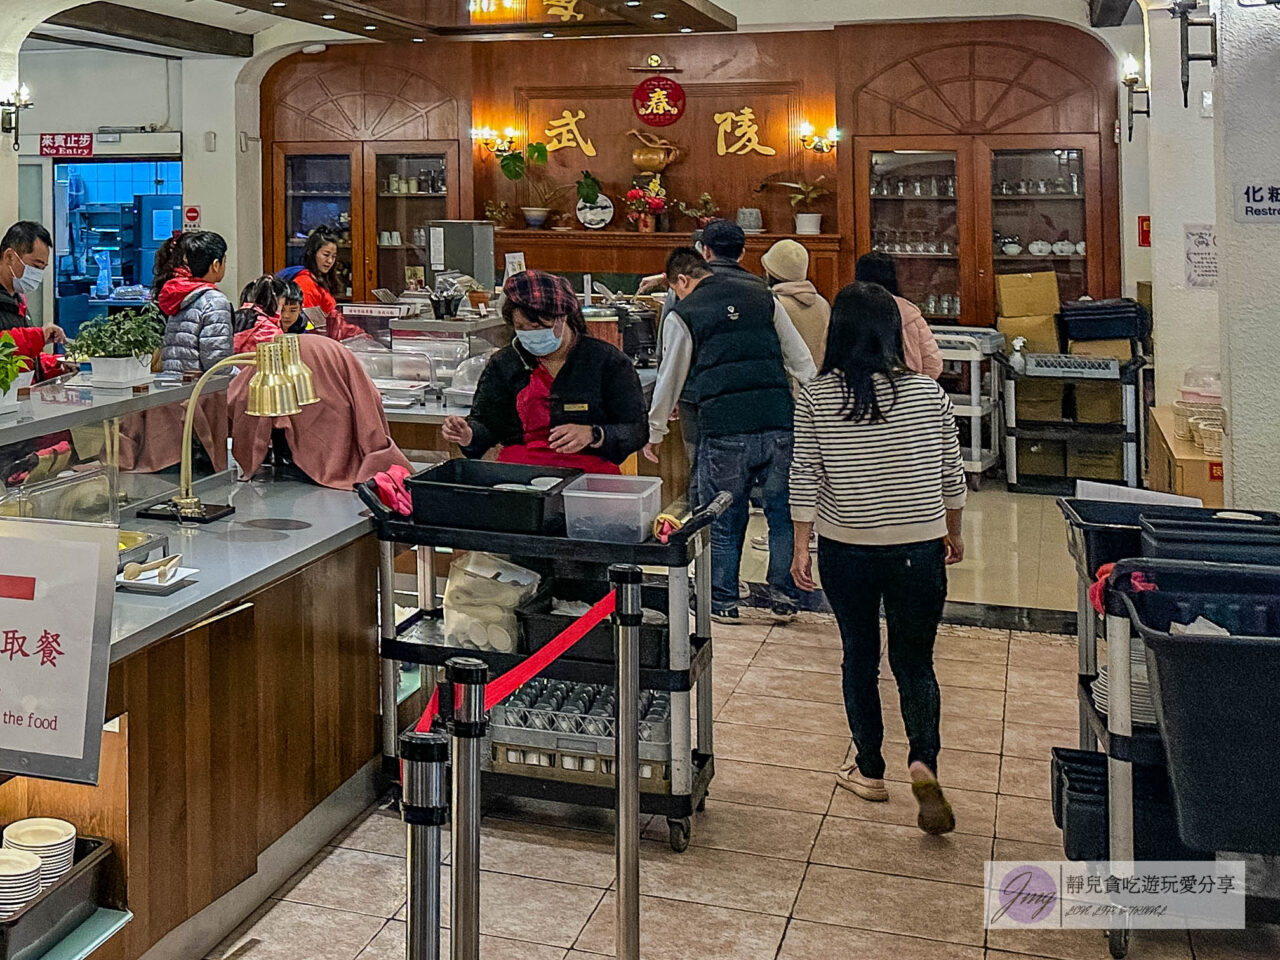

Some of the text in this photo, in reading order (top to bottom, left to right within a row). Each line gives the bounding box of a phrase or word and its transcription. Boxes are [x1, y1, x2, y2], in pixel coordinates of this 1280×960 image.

[545, 106, 776, 157] 武 陵
[41, 134, 91, 147] 來賓止步
[42, 147, 90, 156] No Entry
[3, 710, 23, 725] the
[27, 712, 58, 731] food
